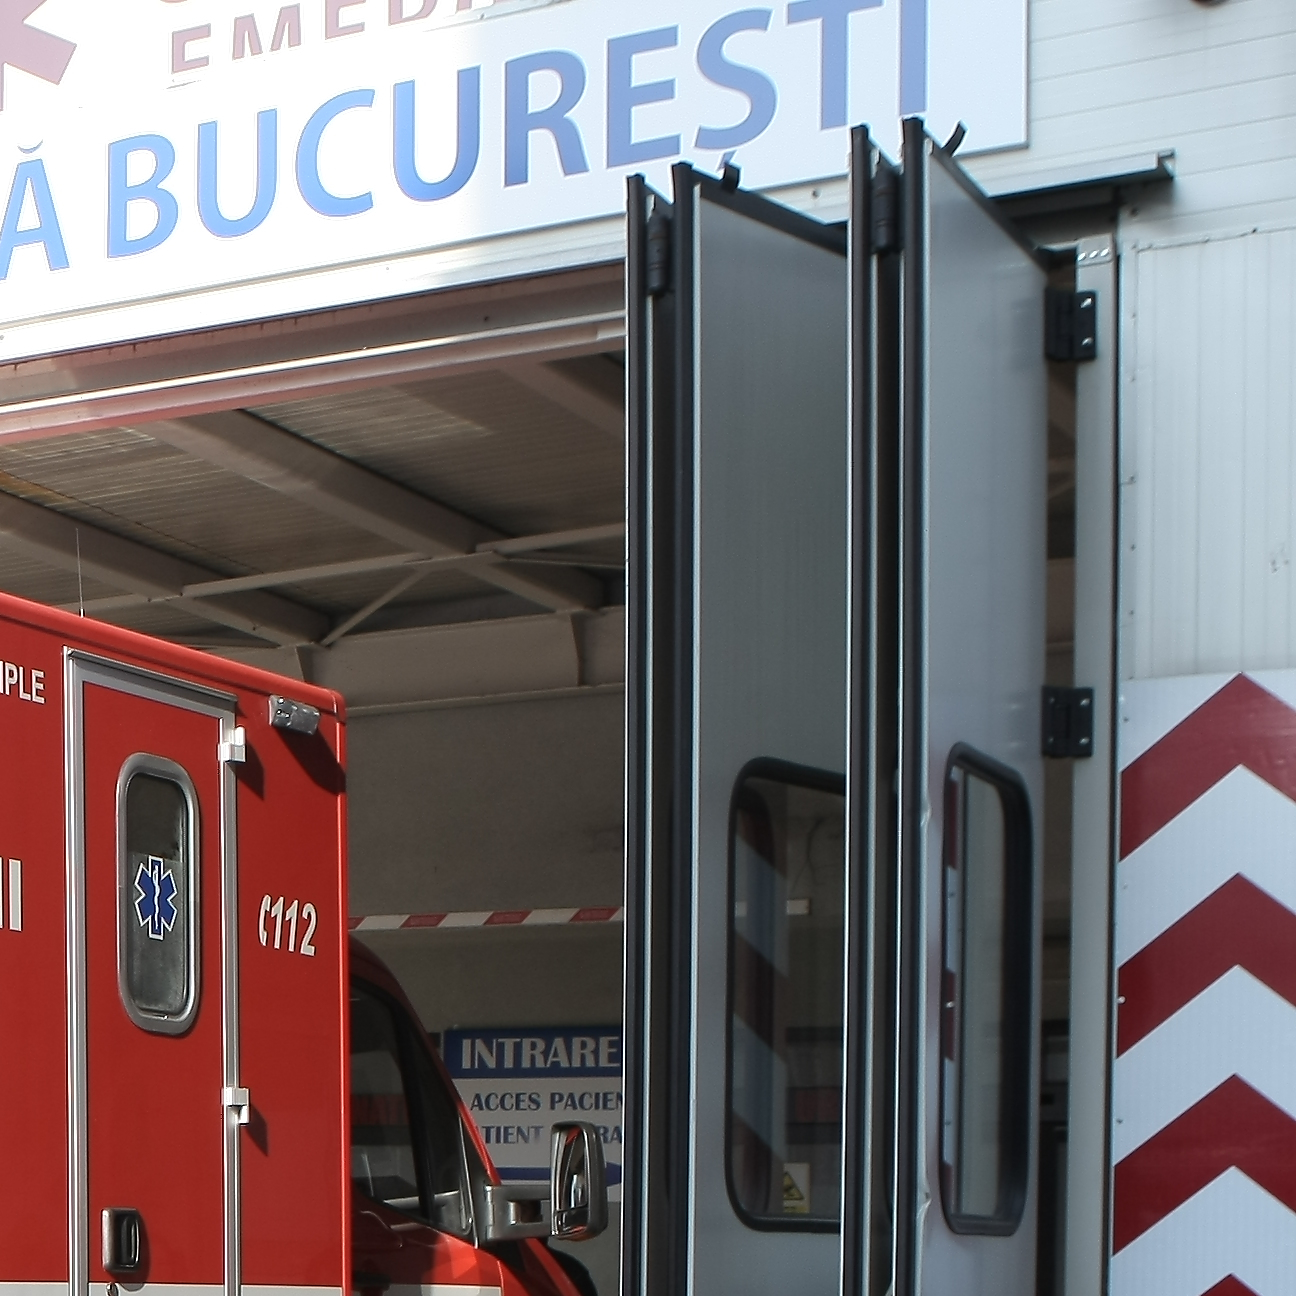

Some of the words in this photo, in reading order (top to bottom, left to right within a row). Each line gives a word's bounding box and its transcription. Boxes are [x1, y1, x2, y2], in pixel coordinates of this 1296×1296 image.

[461, 1036, 621, 1070] INTRARE
[470, 1092, 541, 1111] ACCES
[550, 1092, 622, 1111] PACIEN
[481, 1126, 543, 1145] TIENT
